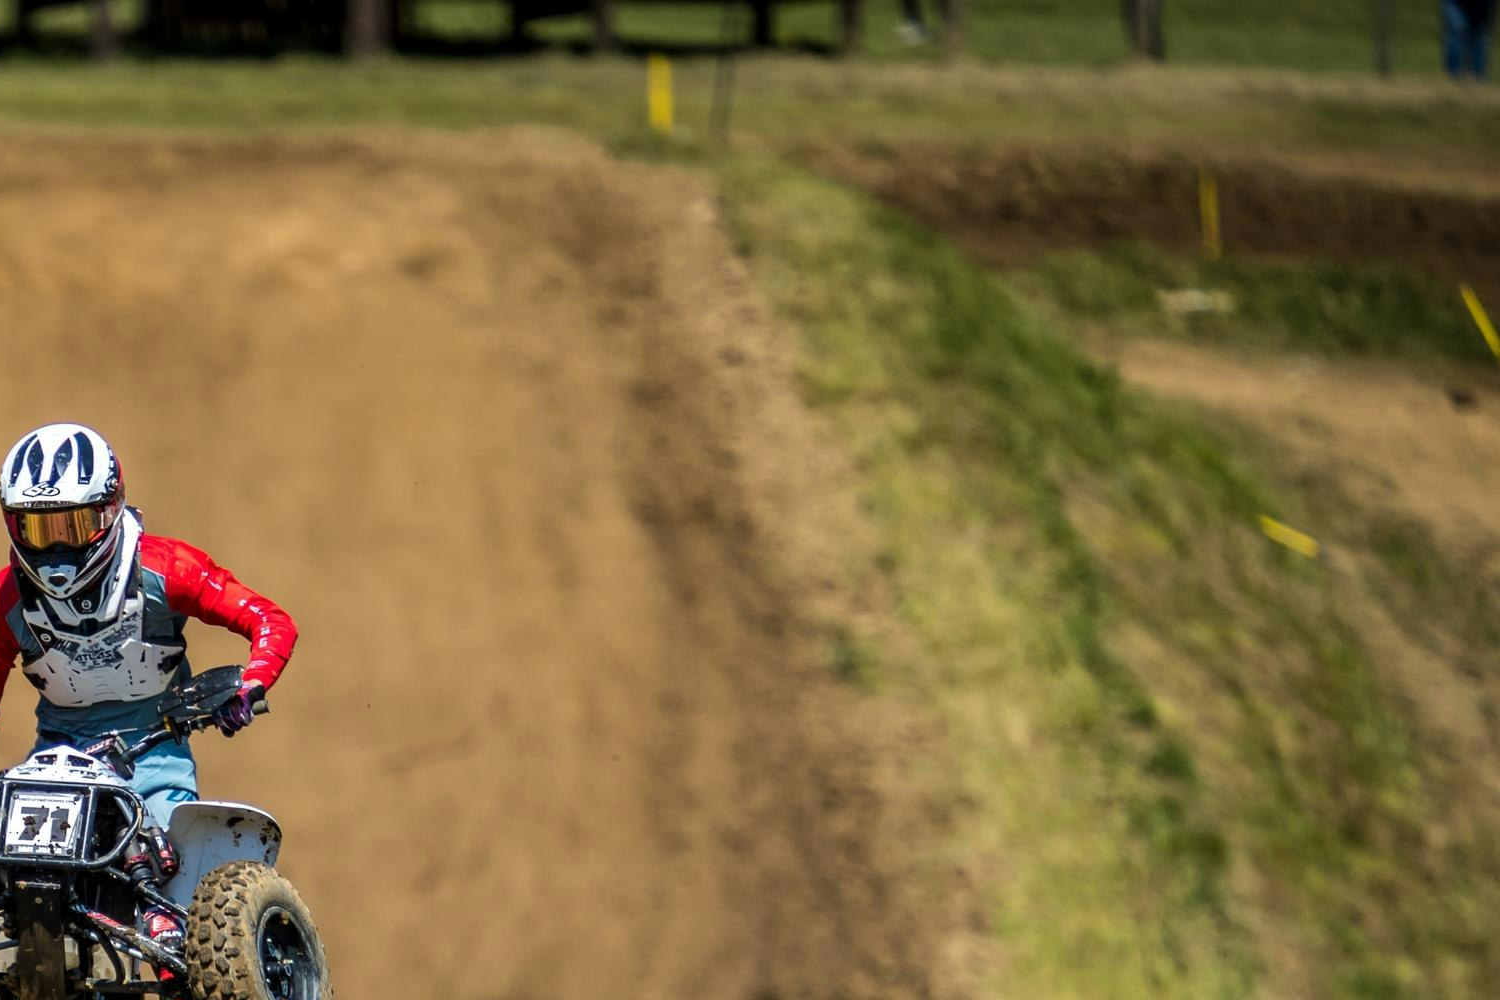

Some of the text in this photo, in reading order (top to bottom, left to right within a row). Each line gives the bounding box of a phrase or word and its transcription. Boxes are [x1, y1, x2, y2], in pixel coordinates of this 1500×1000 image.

[22, 481, 61, 498] 6D
[74, 650, 113, 662] ATLAS
[18, 807, 69, 843] 71
